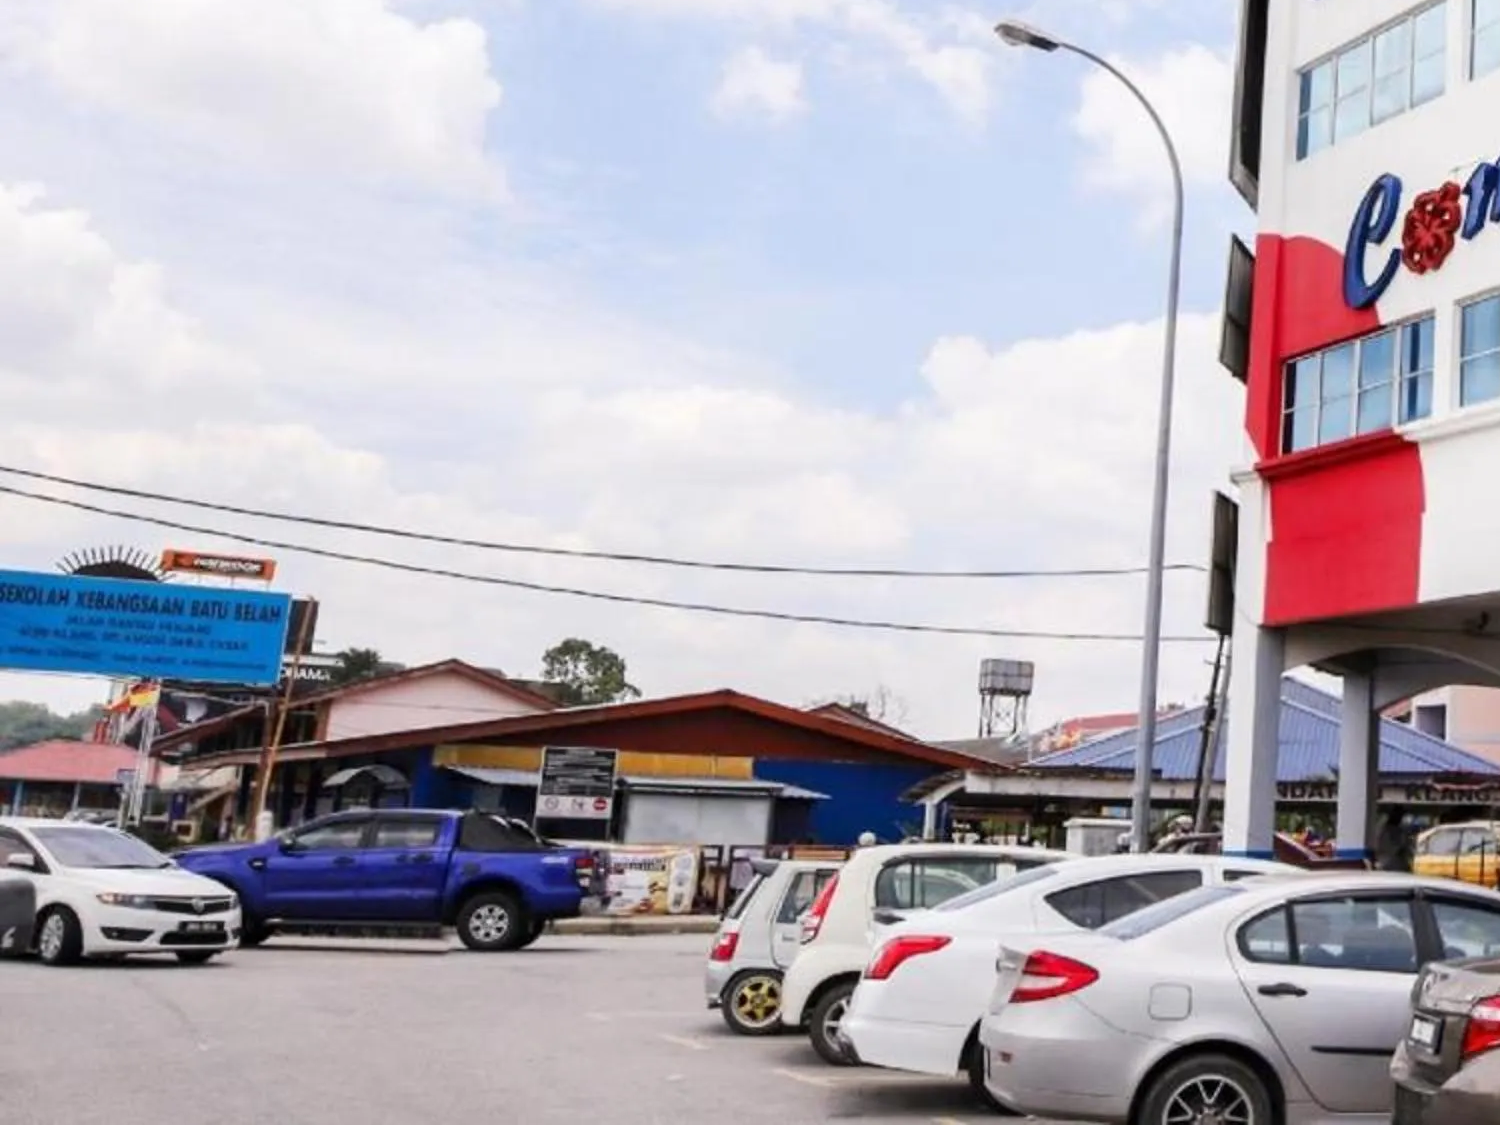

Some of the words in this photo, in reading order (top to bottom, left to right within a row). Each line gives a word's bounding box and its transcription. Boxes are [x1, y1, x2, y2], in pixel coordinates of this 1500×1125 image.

[0, 581, 69, 608] SEKOLAH
[77, 590, 184, 615] KEBANGSAAN
[191, 600, 228, 620] BATU
[234, 603, 281, 623] BELAH
